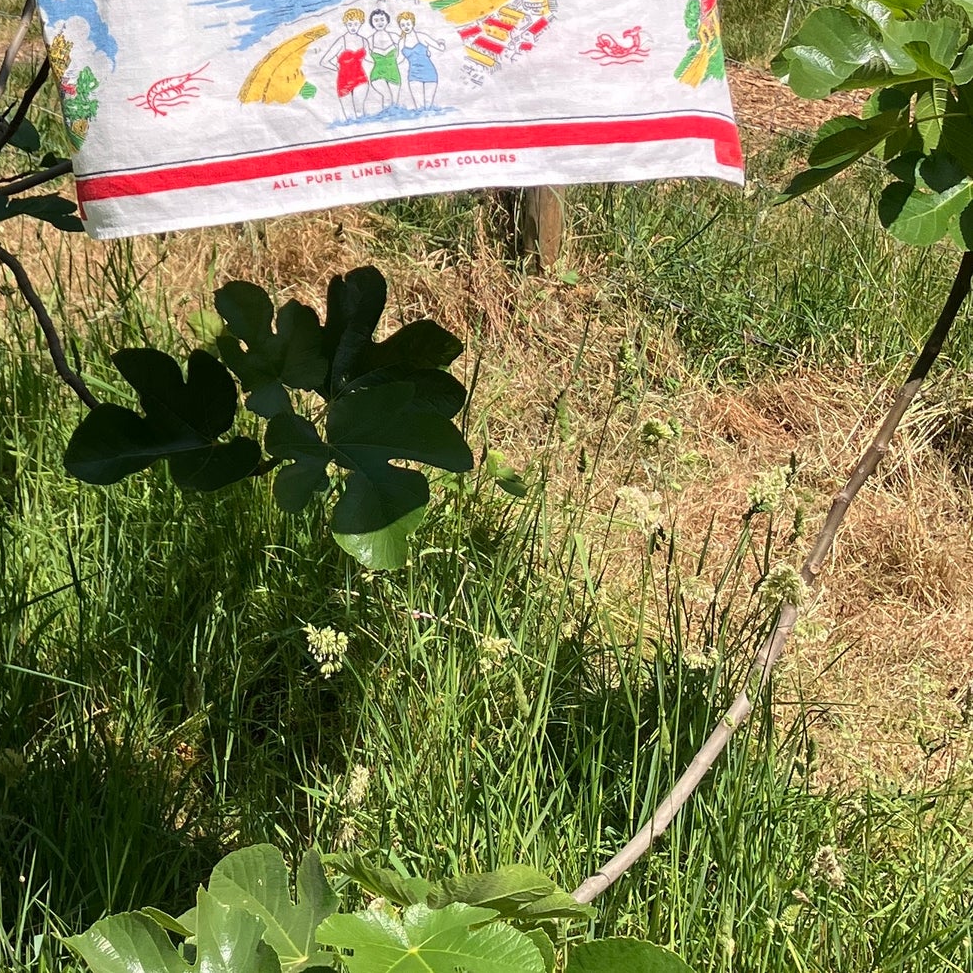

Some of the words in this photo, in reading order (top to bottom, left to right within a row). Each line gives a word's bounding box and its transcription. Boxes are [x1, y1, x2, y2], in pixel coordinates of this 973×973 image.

[272, 179, 299, 191] ALL
[306, 172, 343, 185] PURE
[352, 165, 393, 179] LINEN
[417, 158, 451, 171] FAST
[457, 153, 517, 166] COLOURS
